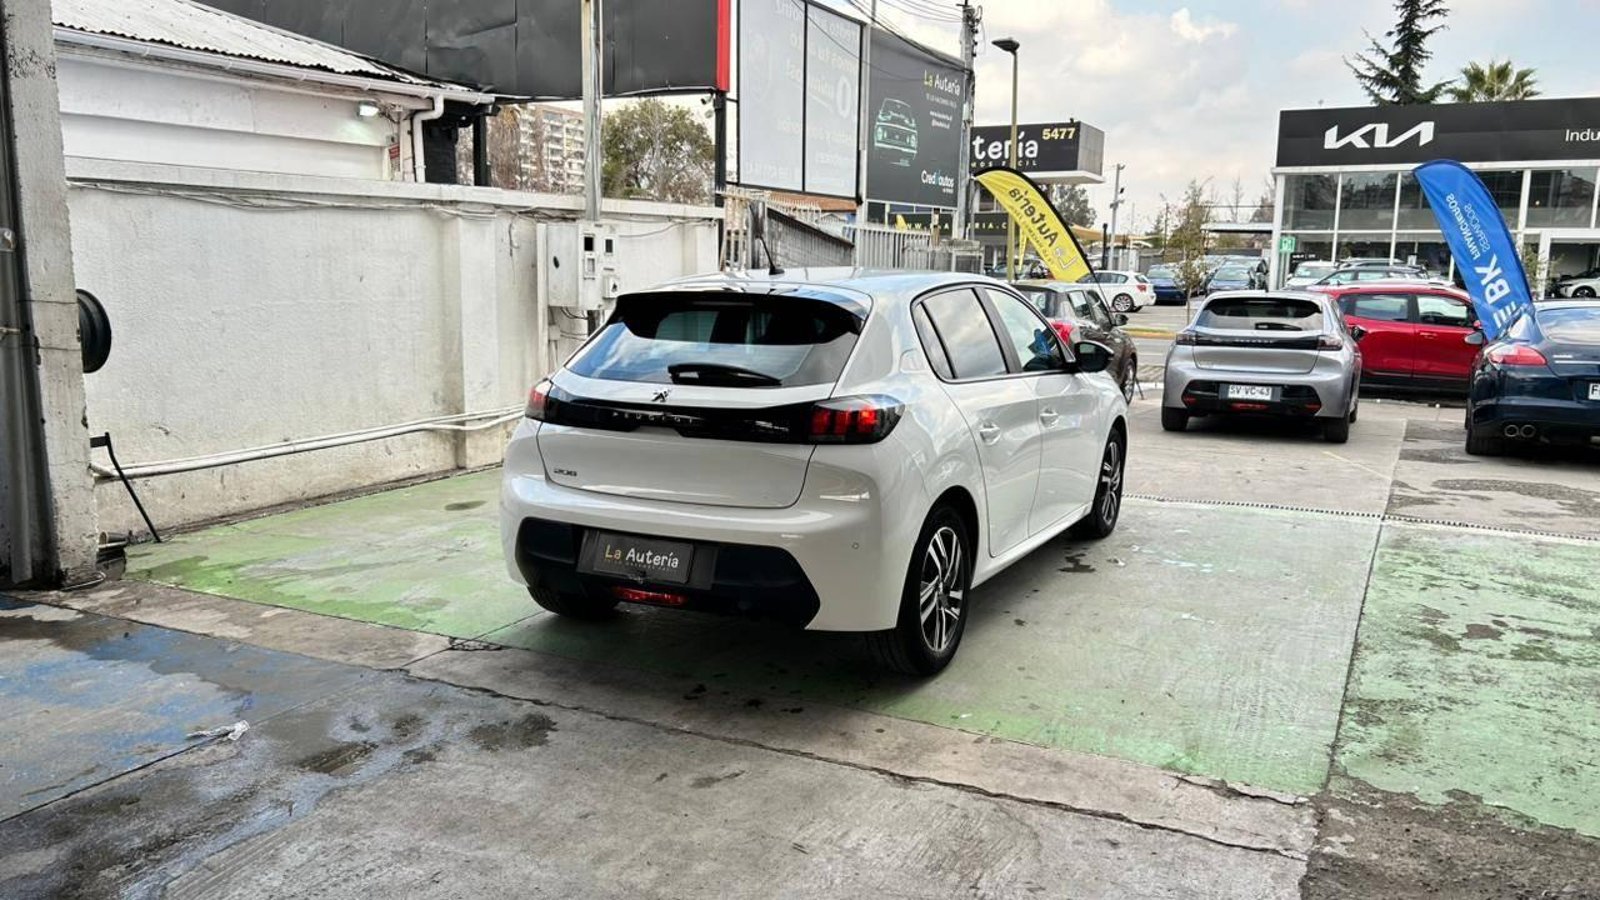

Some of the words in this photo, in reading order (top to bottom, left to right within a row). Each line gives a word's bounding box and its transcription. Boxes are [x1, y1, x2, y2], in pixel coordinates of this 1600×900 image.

[924, 69, 933, 87] La
[1042, 128, 1075, 140] 5477
[1324, 121, 1435, 149] KIA
[1001, 160, 1037, 168] FCIL
[605, 544, 622, 560] La
[625, 547, 679, 568] Autería
